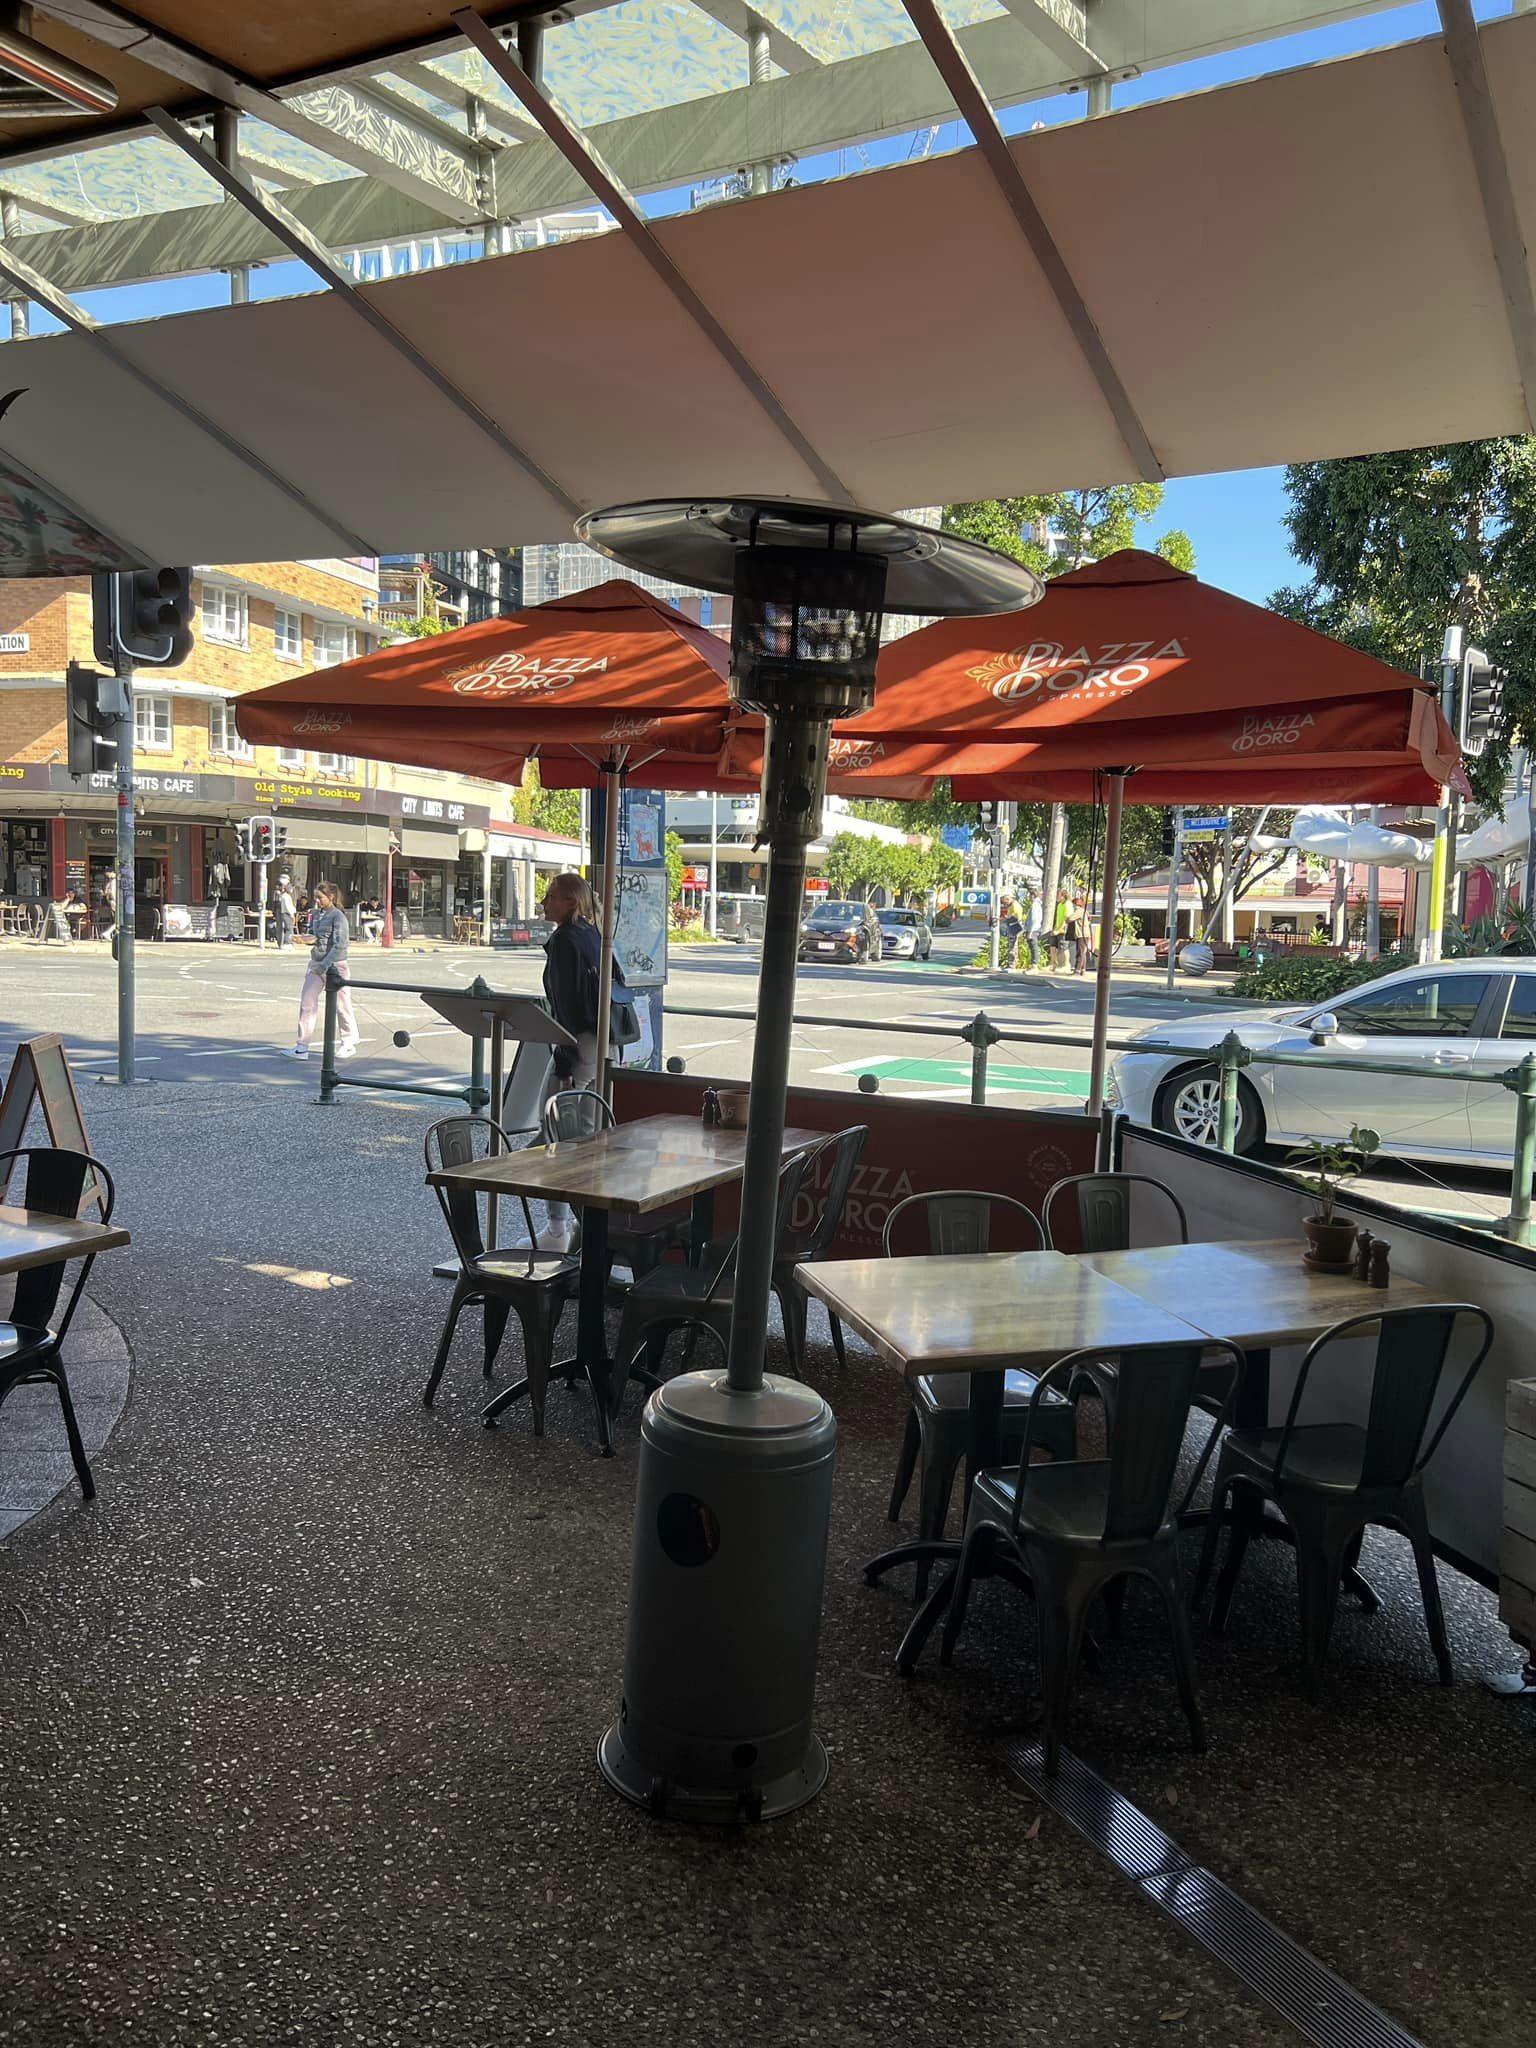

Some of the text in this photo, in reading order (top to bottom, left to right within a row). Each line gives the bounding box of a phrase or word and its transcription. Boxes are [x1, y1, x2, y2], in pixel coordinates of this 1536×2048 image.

[0, 636, 25, 649] TION
[1020, 637, 1186, 671] PIAZZA
[484, 652, 609, 676] PIAZZA
[1037, 688, 1134, 702] ESPRESSO
[163, 777, 195, 793] CAFE
[254, 782, 362, 801] Old Style Cooking
[402, 796, 419, 814] CITY
[447, 803, 465, 820] CAFE
[100, 827, 115, 836] CITY
[136, 828, 154, 837] CAFE
[799, 1154, 914, 1200] IZZA
